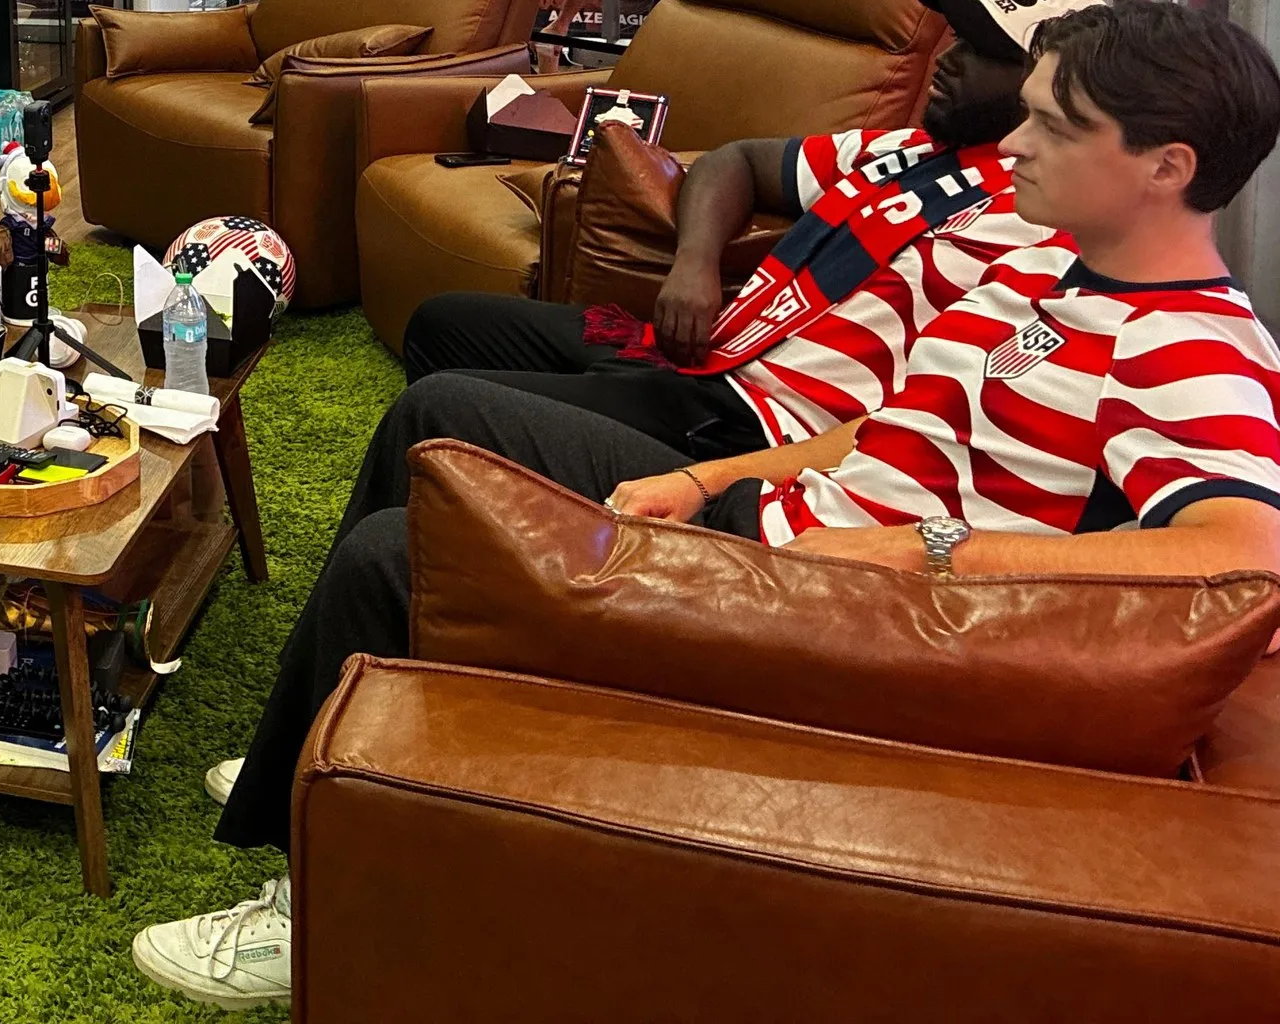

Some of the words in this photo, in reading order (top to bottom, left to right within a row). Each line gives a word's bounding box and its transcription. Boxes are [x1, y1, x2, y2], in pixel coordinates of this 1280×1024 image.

[548, 10, 603, 24] AAZE
[1022, 323, 1061, 353] USA
[239, 949, 274, 961] Reebok
